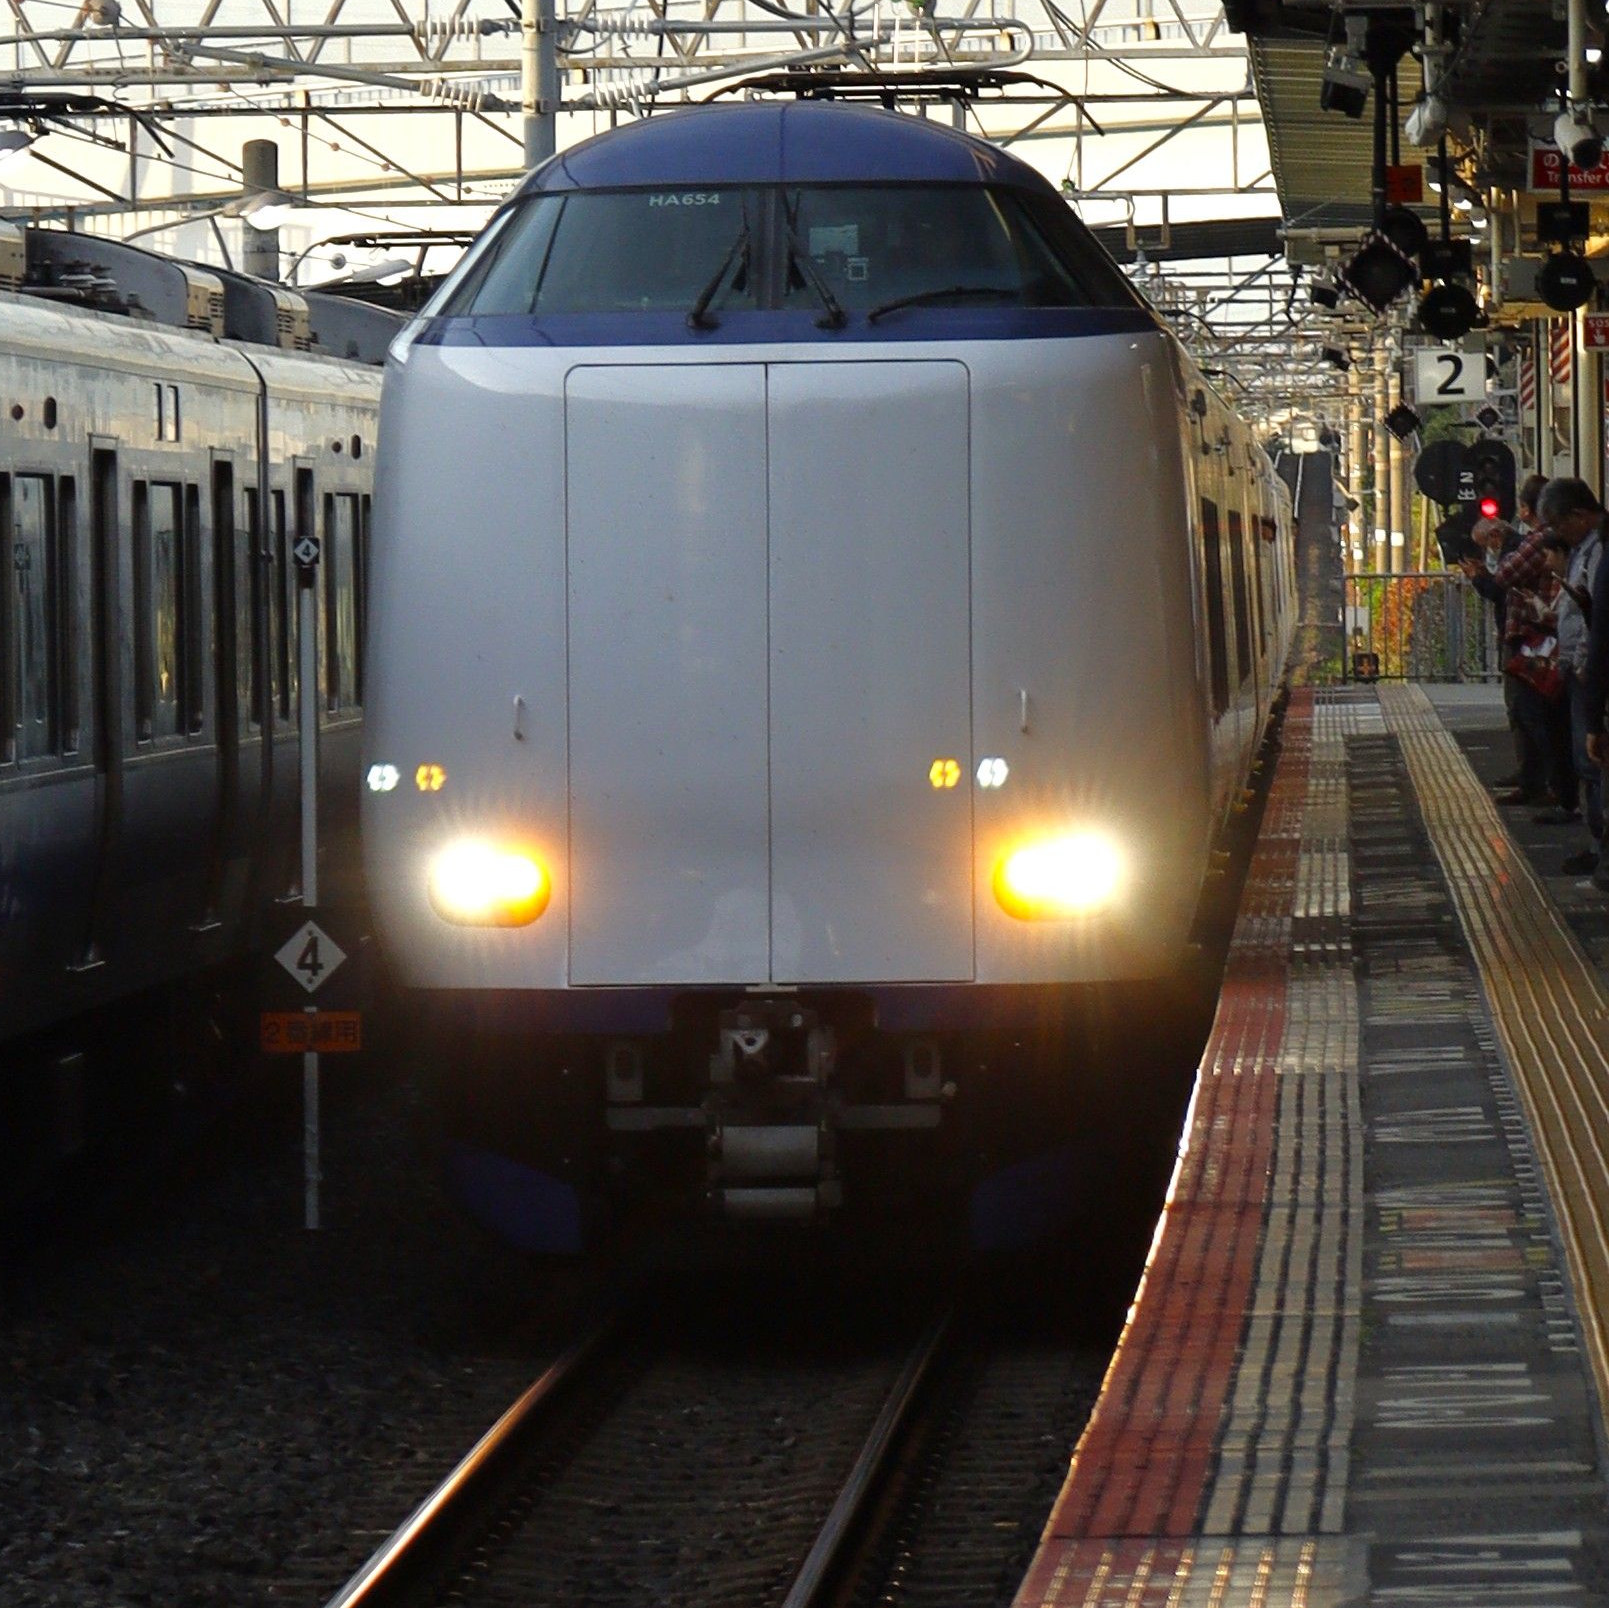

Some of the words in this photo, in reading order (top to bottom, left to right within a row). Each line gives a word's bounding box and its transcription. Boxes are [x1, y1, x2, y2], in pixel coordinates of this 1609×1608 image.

[1546, 171, 1601, 184] Trnsfer
[648, 193, 721, 207] HA654
[1436, 354, 1466, 396] 2
[302, 544, 311, 556] 4
[297, 935, 324, 977] 4
